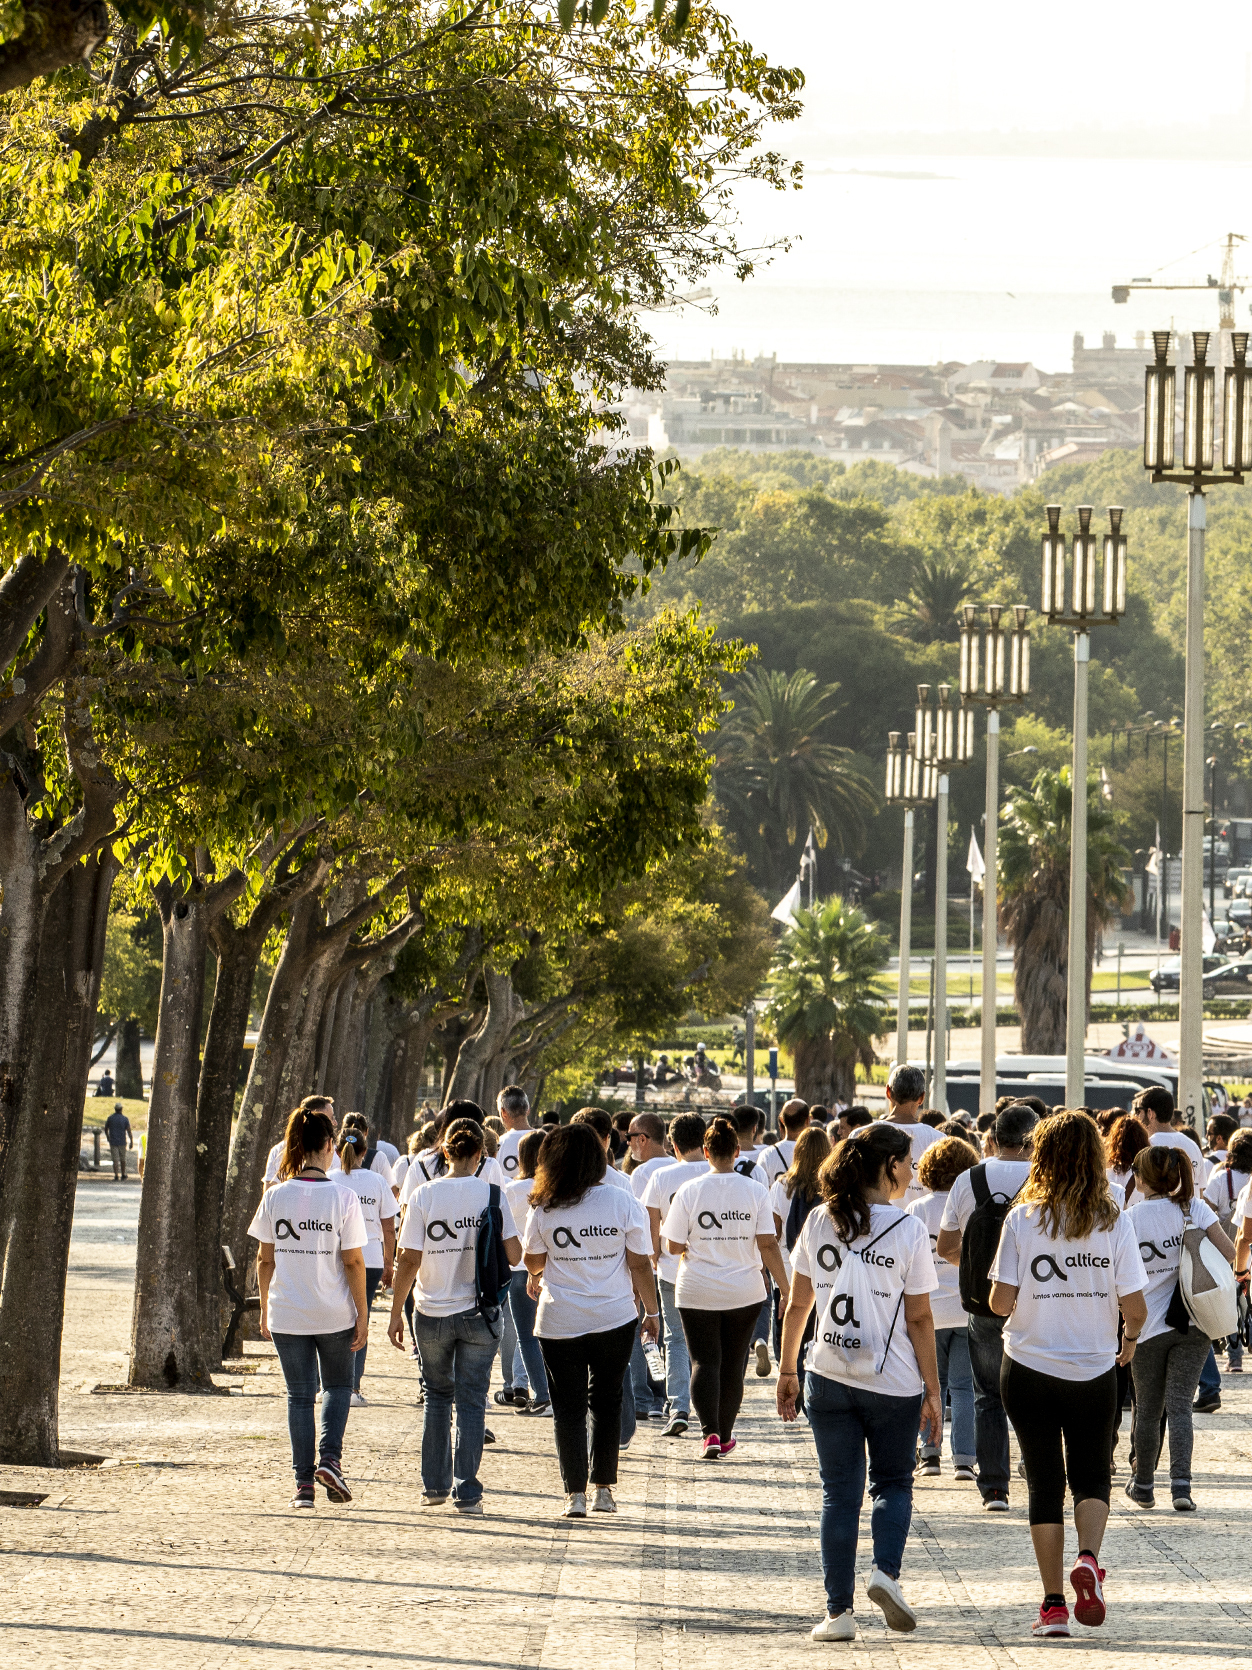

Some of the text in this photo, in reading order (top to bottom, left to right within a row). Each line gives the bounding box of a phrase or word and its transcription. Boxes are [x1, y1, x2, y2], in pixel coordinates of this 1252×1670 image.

[720, 1210, 751, 1221] altice
[298, 1219, 333, 1232] altice
[579, 1224, 618, 1237] altice
[1065, 1252, 1110, 1268] altice
[823, 1331, 861, 1349] altice
